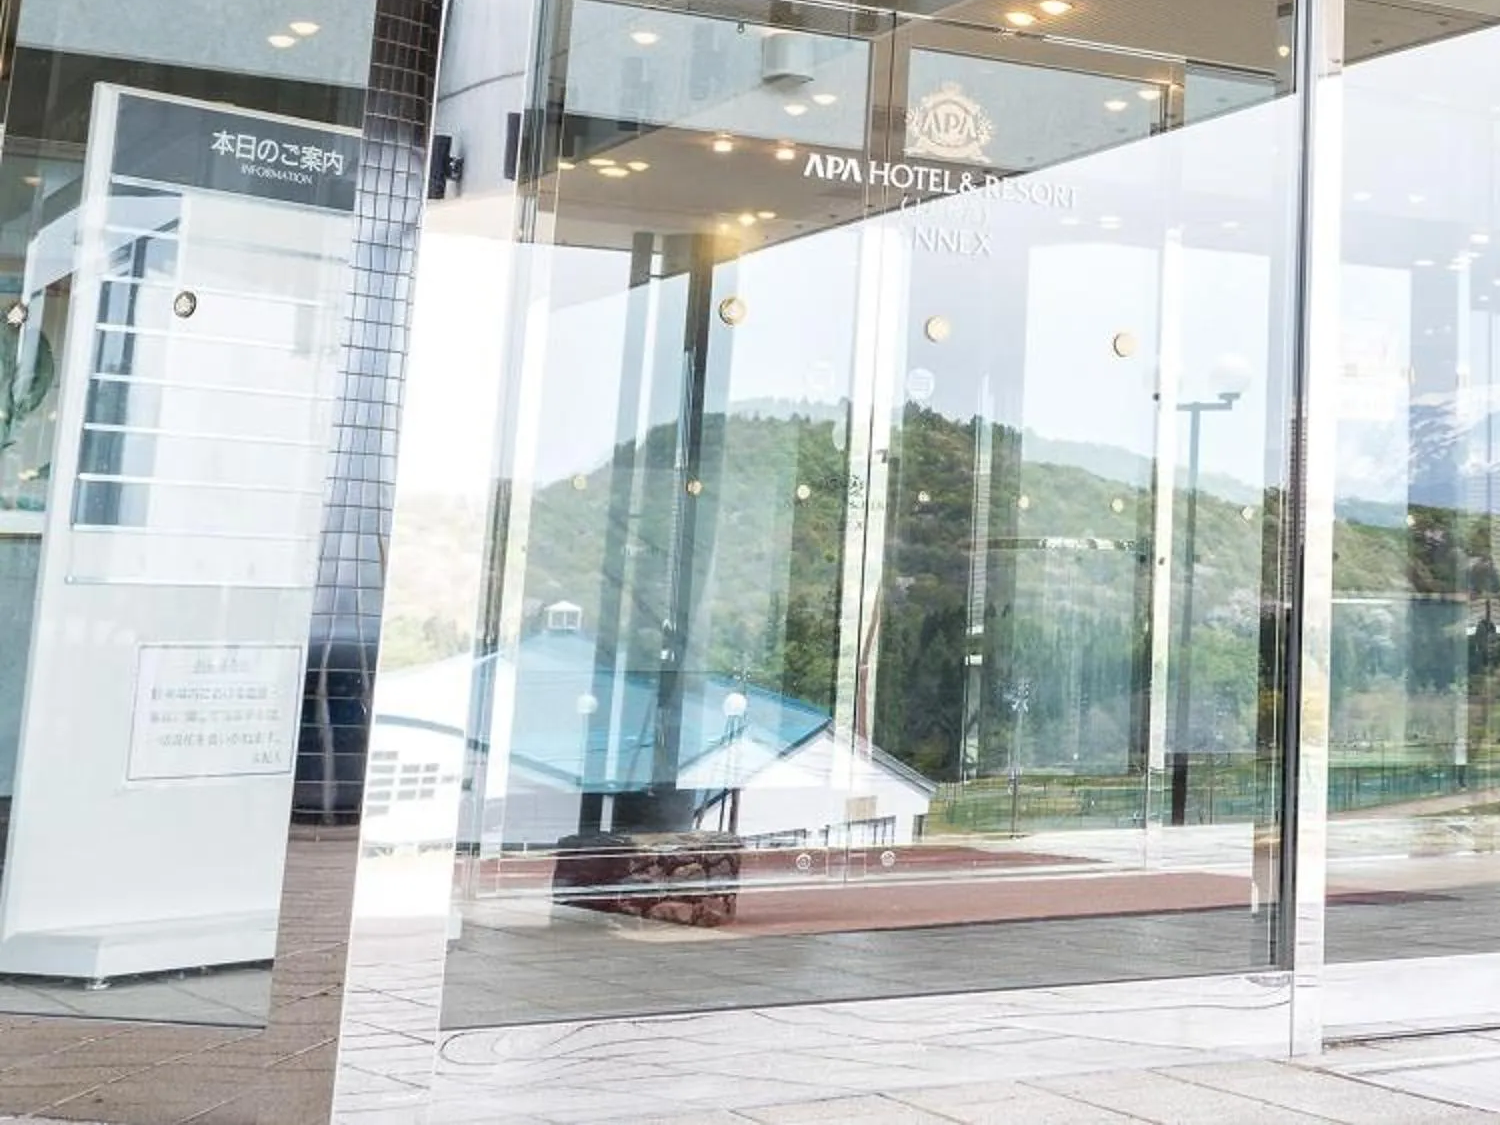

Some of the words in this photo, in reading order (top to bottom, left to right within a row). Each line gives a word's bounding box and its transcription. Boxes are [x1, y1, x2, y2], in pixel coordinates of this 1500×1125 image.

[211, 129, 345, 176] 本日のご案内
[240, 162, 313, 184] INFORMATION
[803, 153, 862, 184] APA
